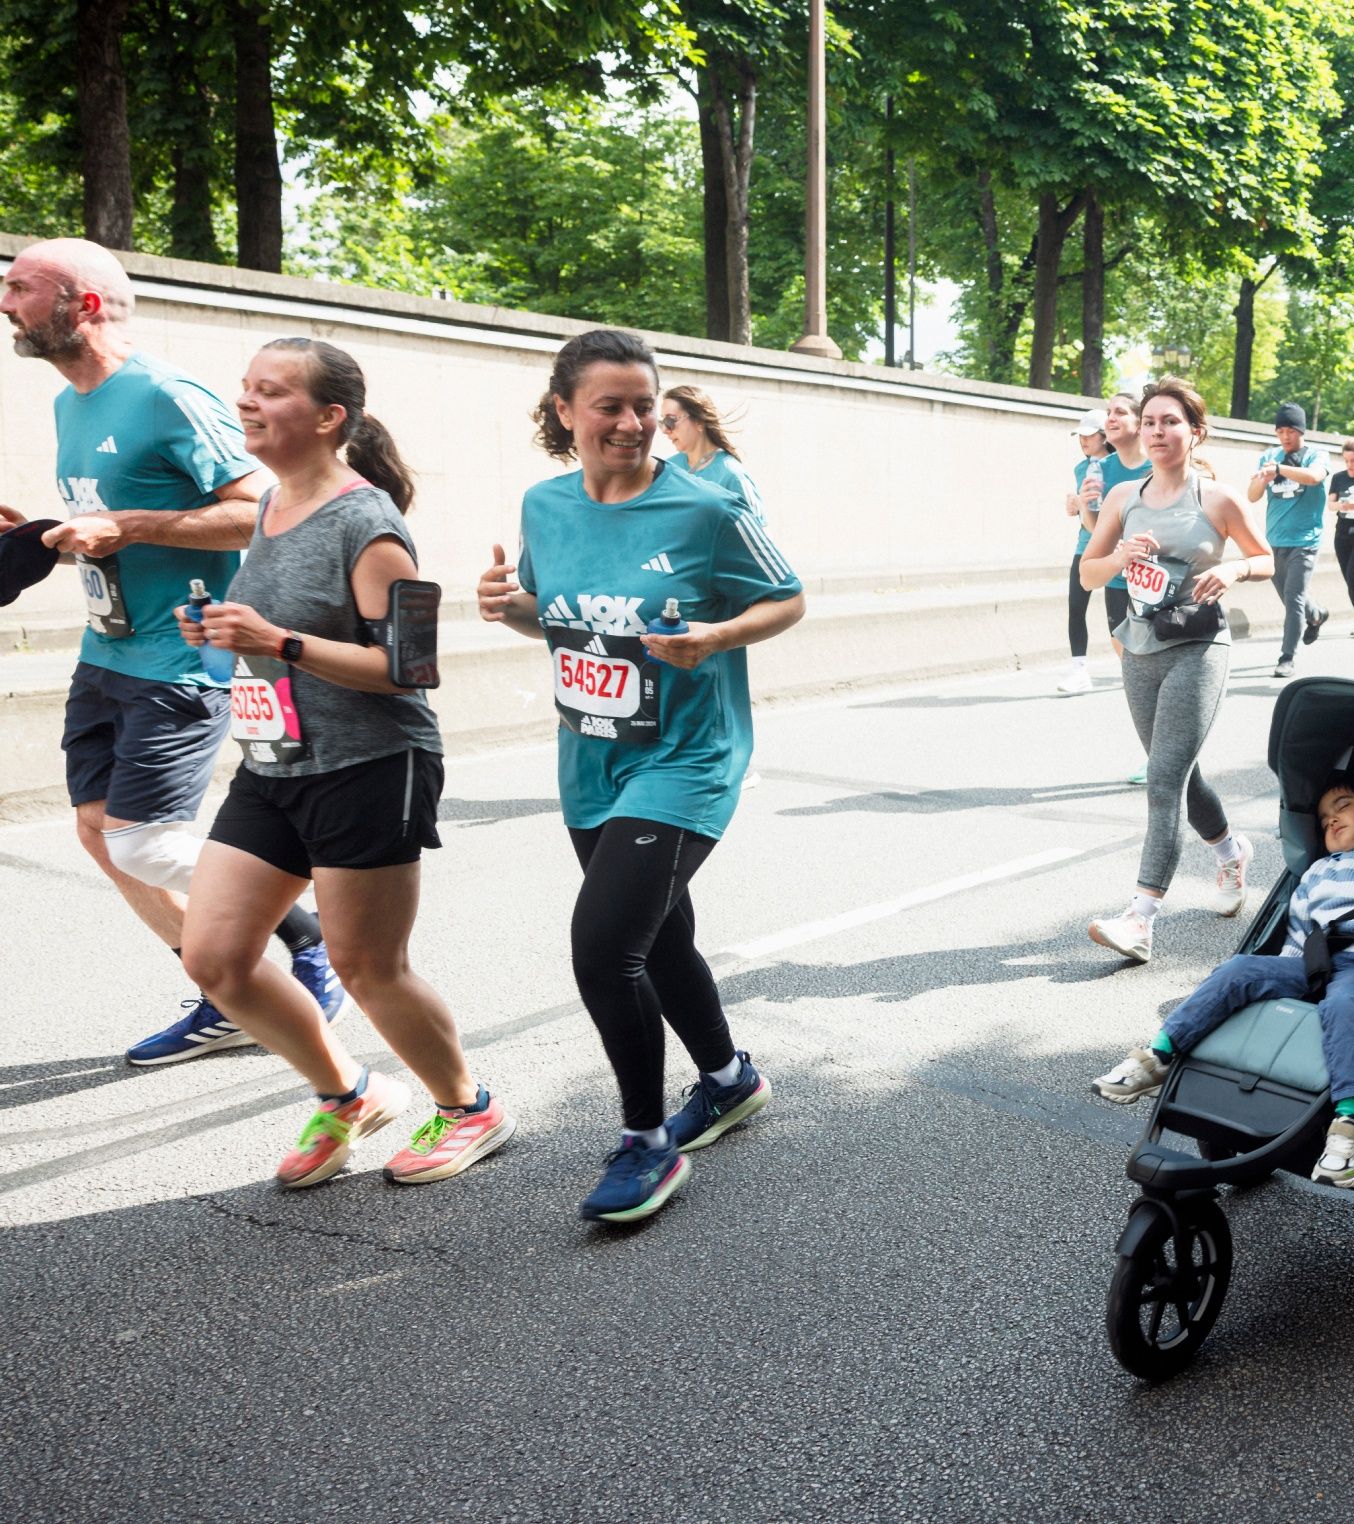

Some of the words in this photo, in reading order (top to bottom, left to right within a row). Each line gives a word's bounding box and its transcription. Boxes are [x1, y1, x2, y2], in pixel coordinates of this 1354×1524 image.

[79, 567, 104, 600] 60
[1126, 561, 1164, 593] 3330
[577, 594, 647, 623] 10K
[560, 653, 629, 699] 54527
[580, 722, 618, 739] PARIS
